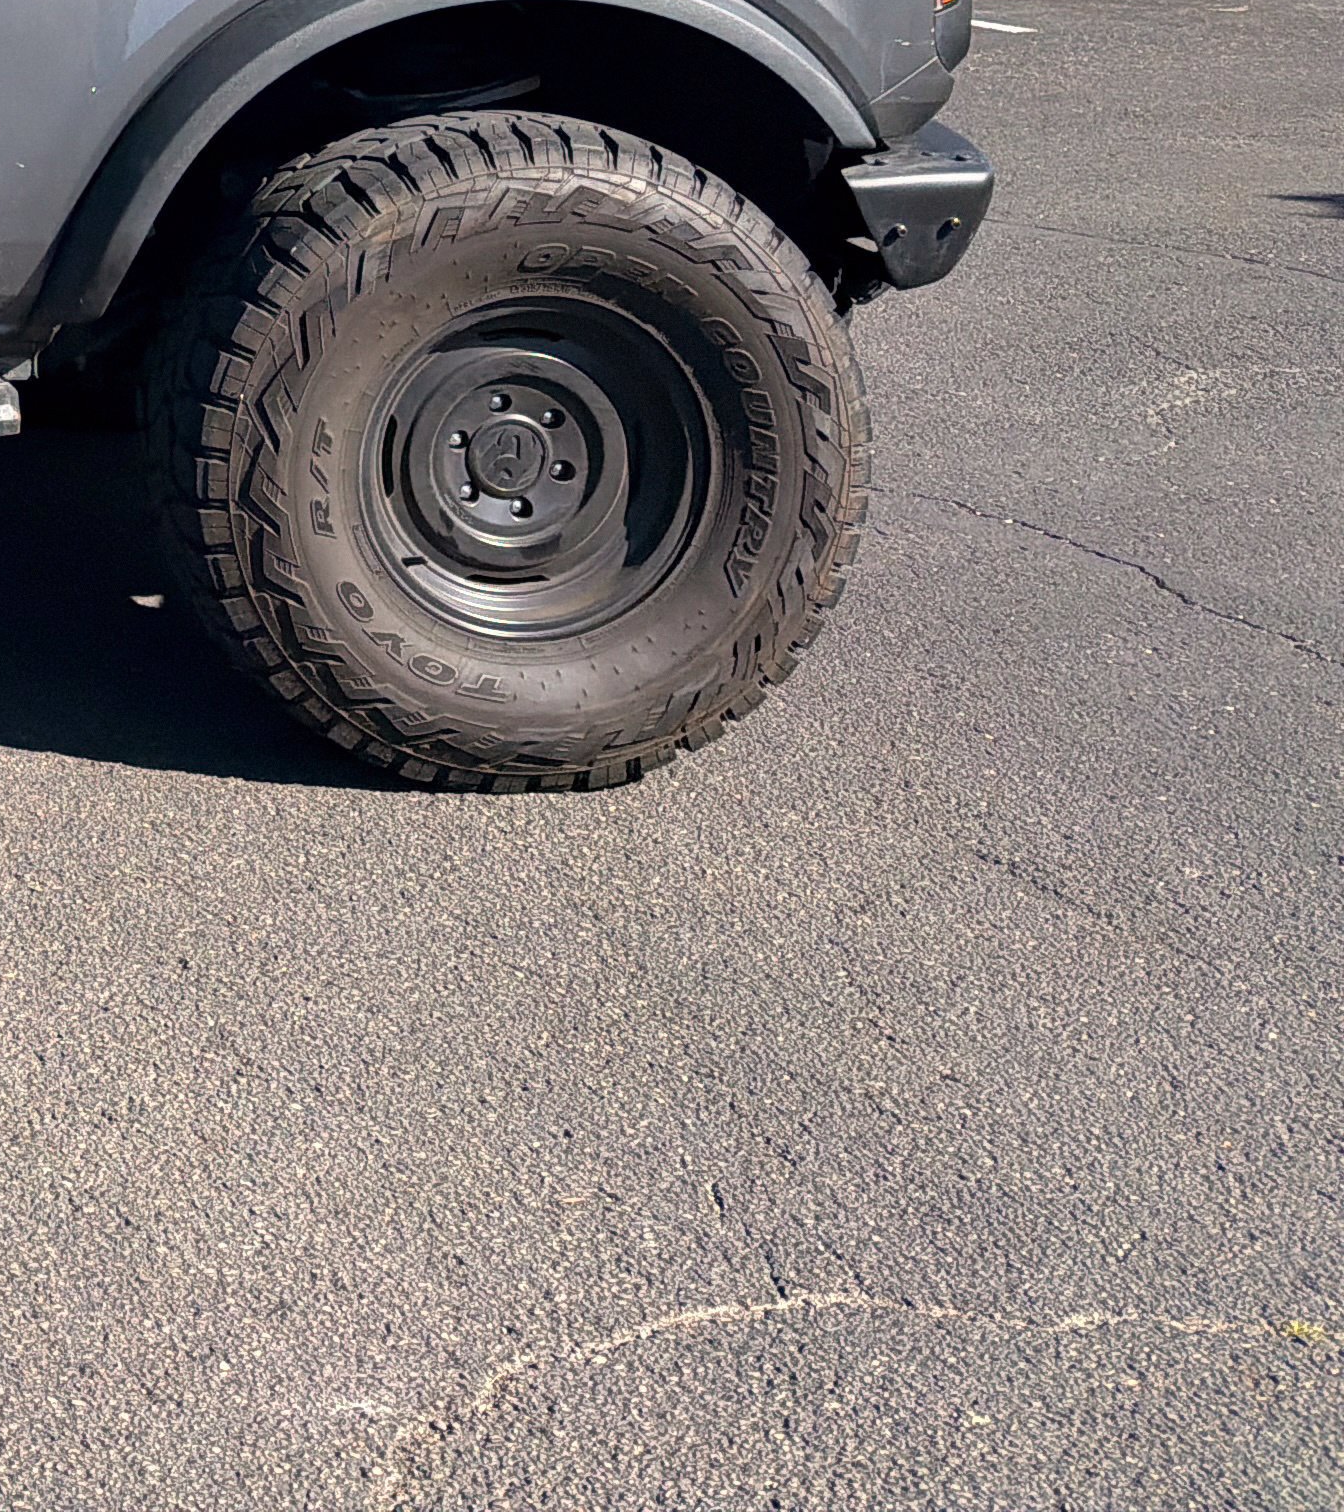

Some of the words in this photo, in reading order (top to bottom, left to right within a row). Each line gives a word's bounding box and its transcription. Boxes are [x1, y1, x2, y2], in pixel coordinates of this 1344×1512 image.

[310, 417, 338, 539] R/T
[517, 243, 699, 296] OPEN
[698, 316, 780, 598] COUNTRY
[336, 580, 511, 704] TOYO
